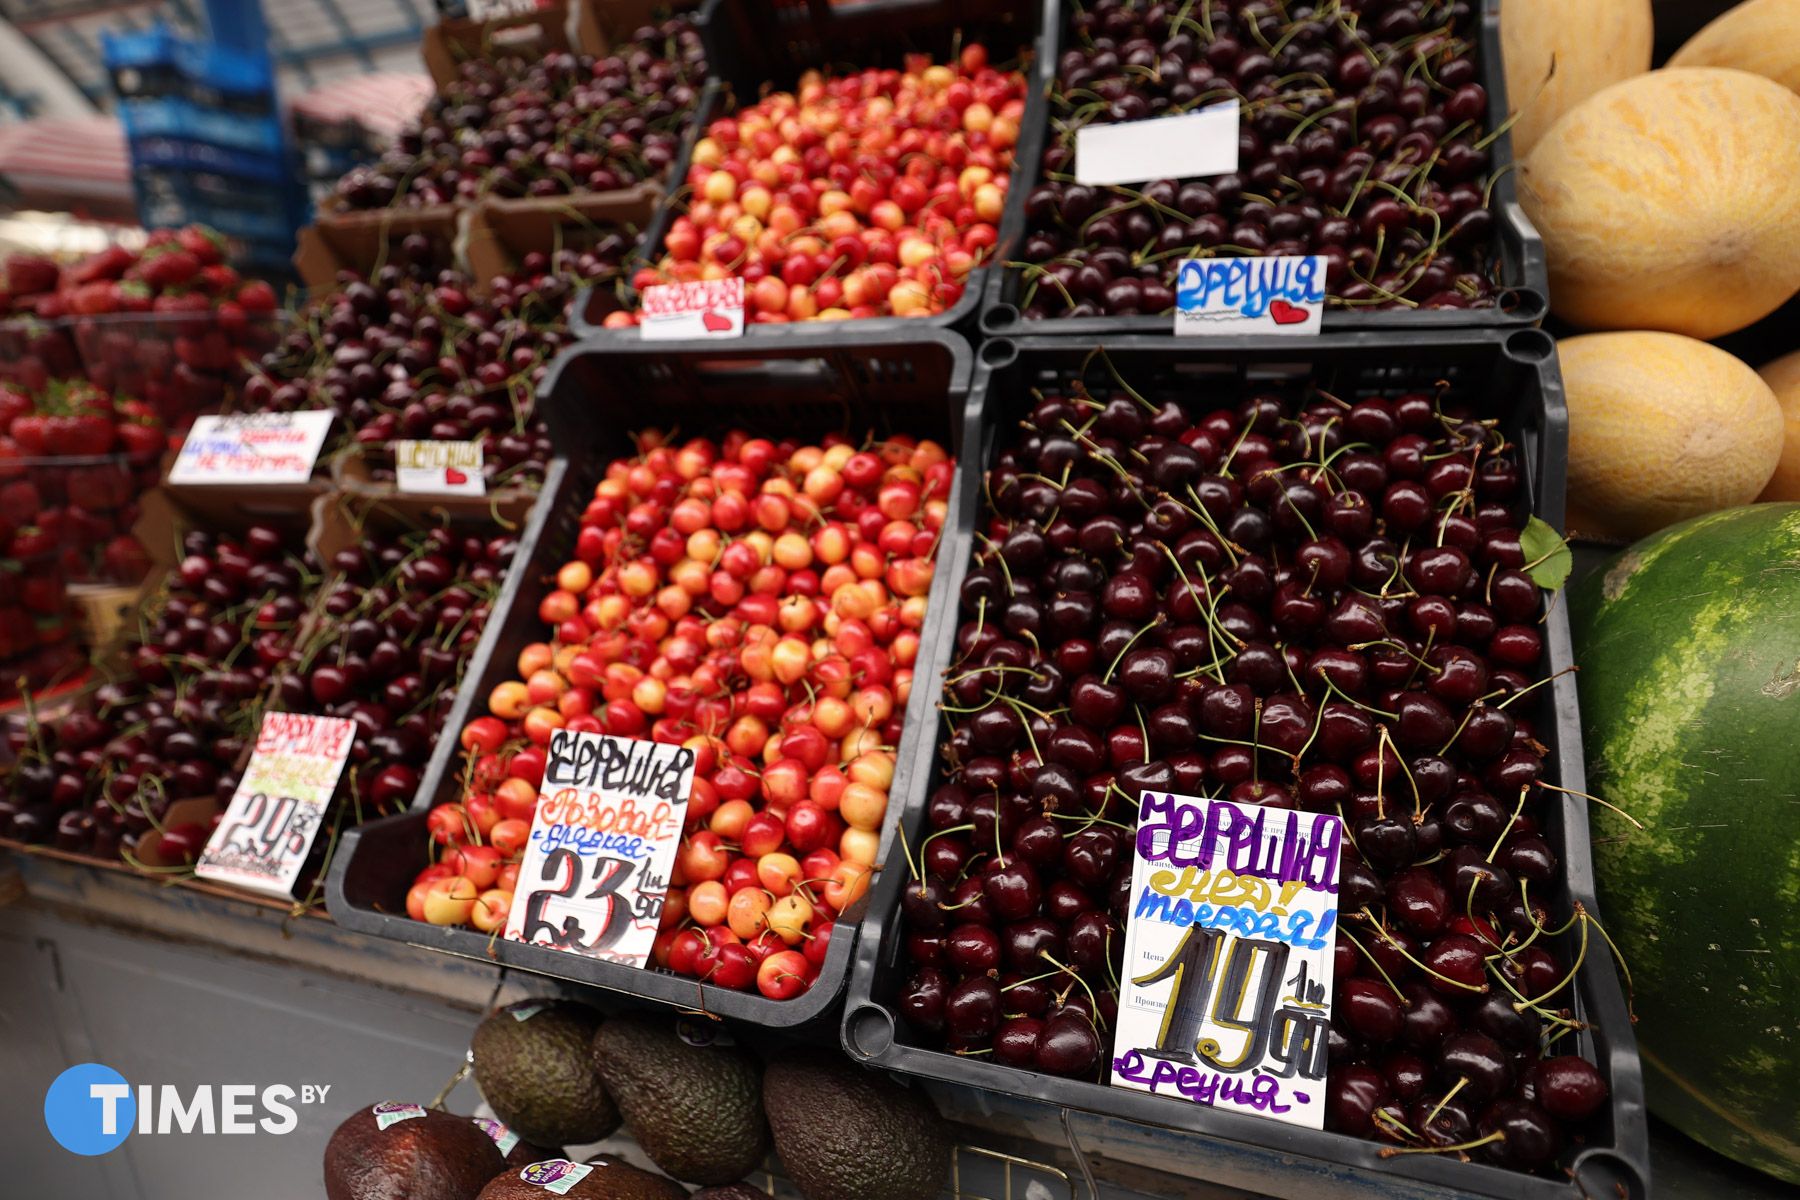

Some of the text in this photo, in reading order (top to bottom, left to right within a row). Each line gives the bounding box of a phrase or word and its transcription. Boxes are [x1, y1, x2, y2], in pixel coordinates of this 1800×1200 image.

[547, 731, 694, 804] Черешня
[1136, 793, 1342, 894] Черешня
[523, 848, 636, 954] 23
[1131, 921, 1291, 1074] 19
[1143, 951, 1165, 962] Цена
[1135, 995, 1169, 1009] Произво
